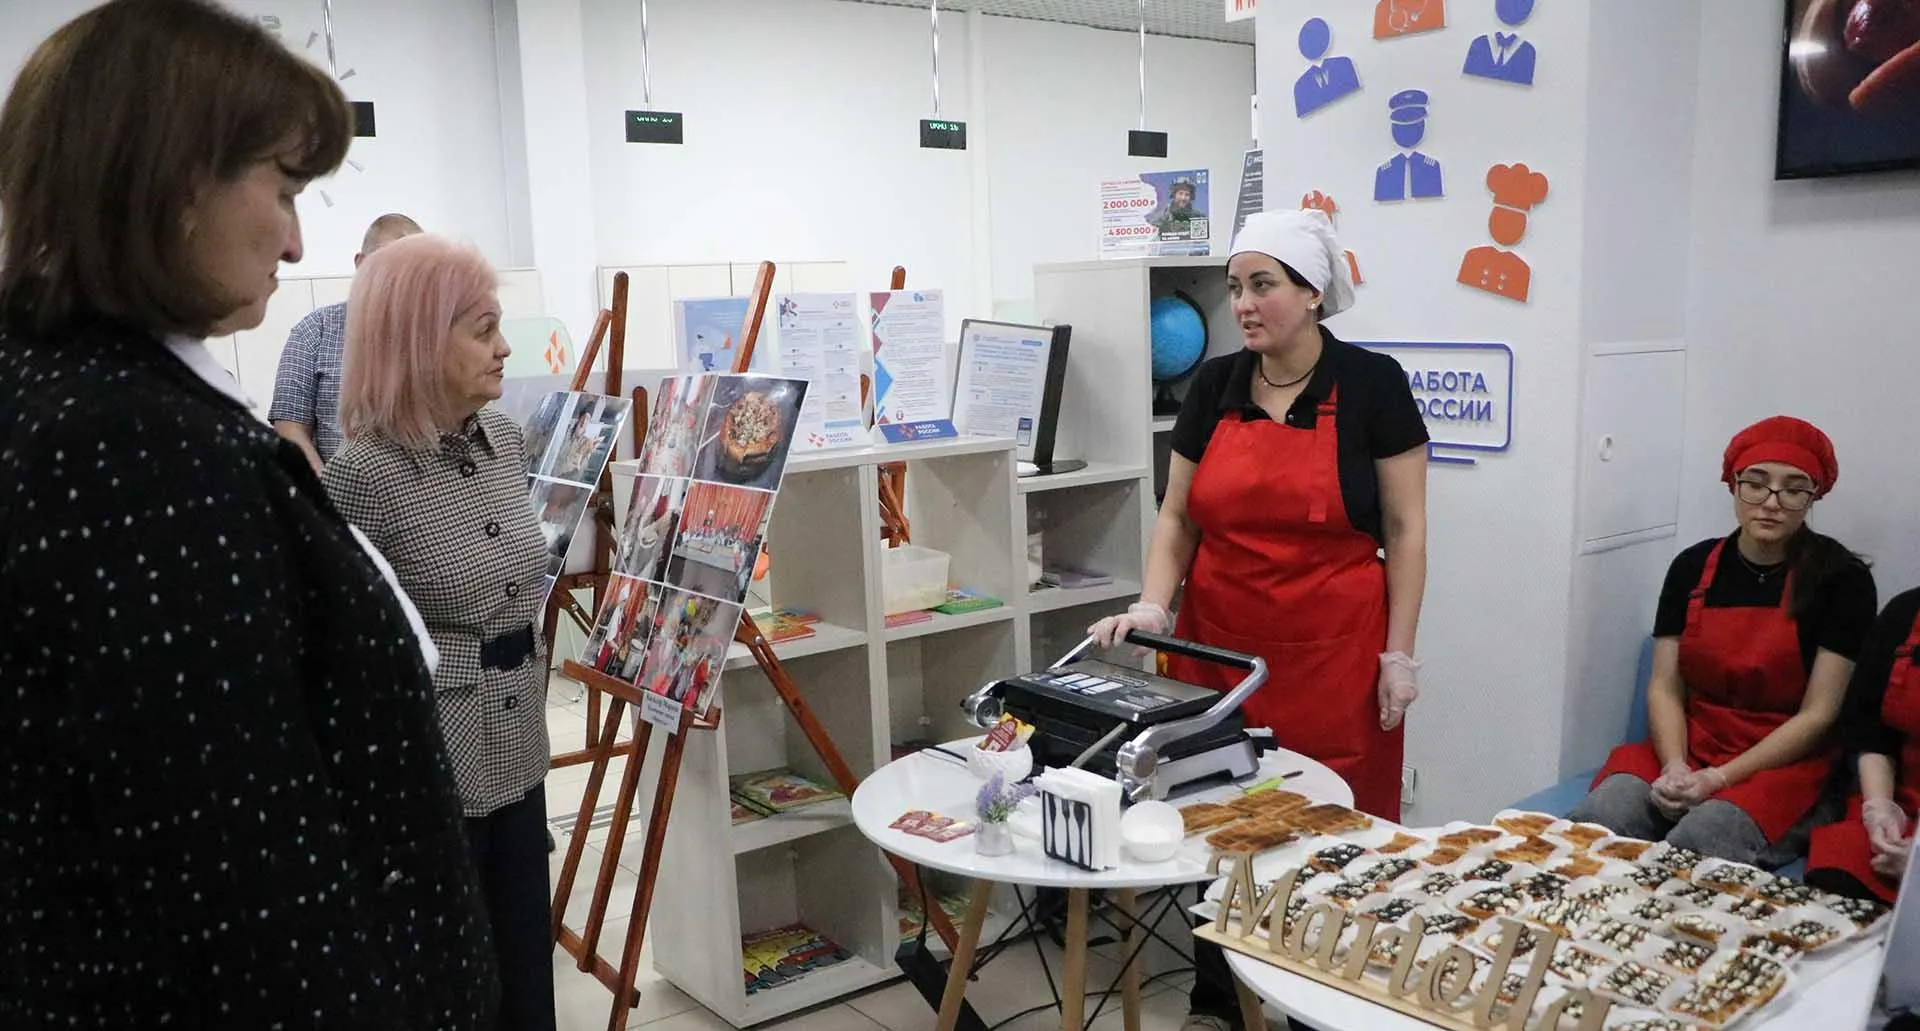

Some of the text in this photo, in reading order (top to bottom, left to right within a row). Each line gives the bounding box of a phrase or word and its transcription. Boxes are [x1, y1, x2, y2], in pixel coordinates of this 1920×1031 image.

[1110, 200, 1129, 209] 000
[1130, 199, 1149, 207] 000
[1115, 228, 1132, 236] 500
[1133, 226, 1151, 234] 000
[1404, 370, 1488, 393] АБОТА
[1414, 397, 1493, 421] ОССИИ
